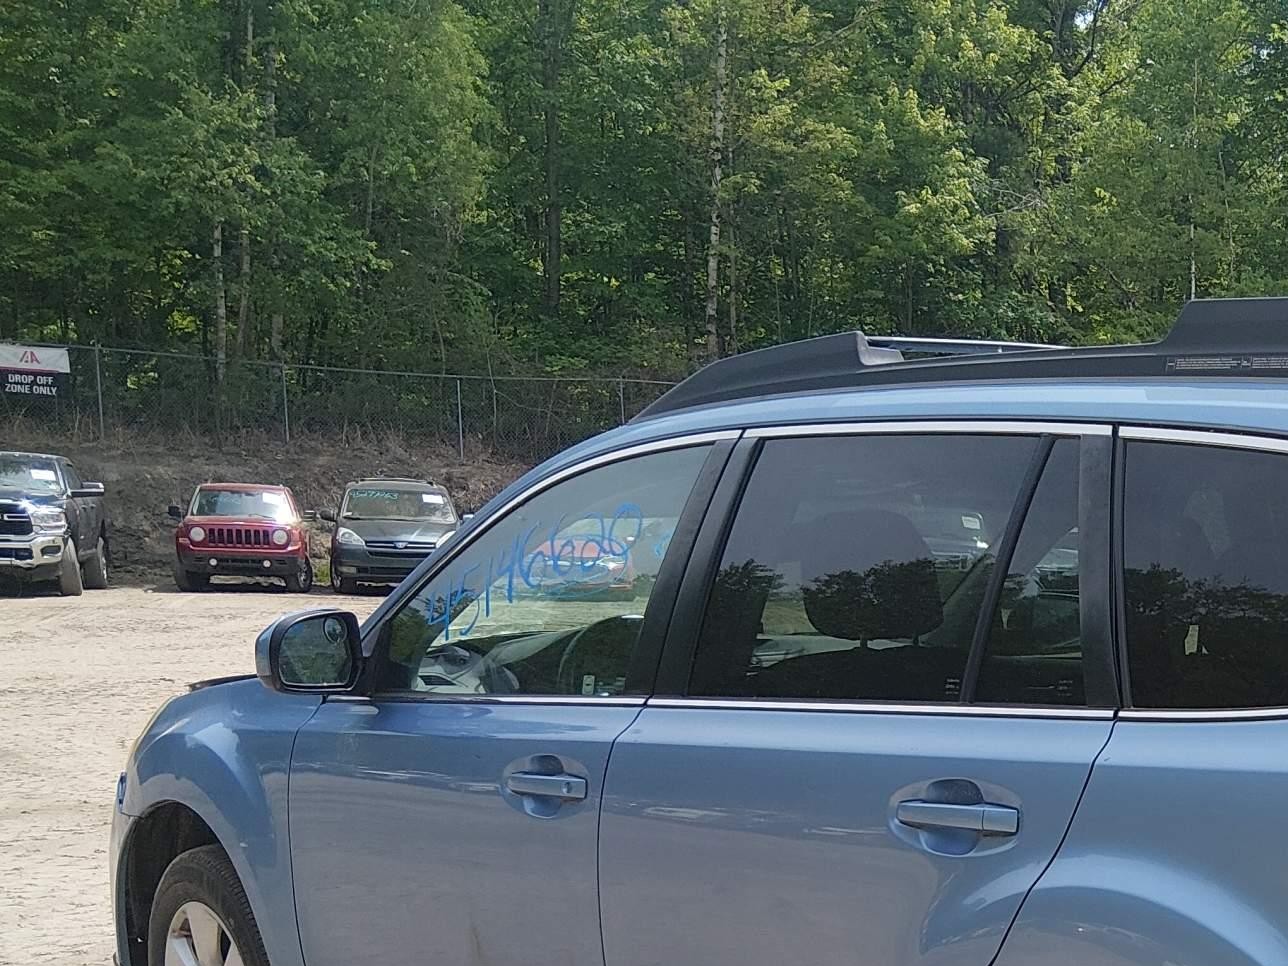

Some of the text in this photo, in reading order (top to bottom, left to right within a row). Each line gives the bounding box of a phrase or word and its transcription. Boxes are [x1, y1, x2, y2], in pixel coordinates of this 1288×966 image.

[8, 374, 54, 385] DROP OFF
[5, 383, 57, 396] ZONE ONLY
